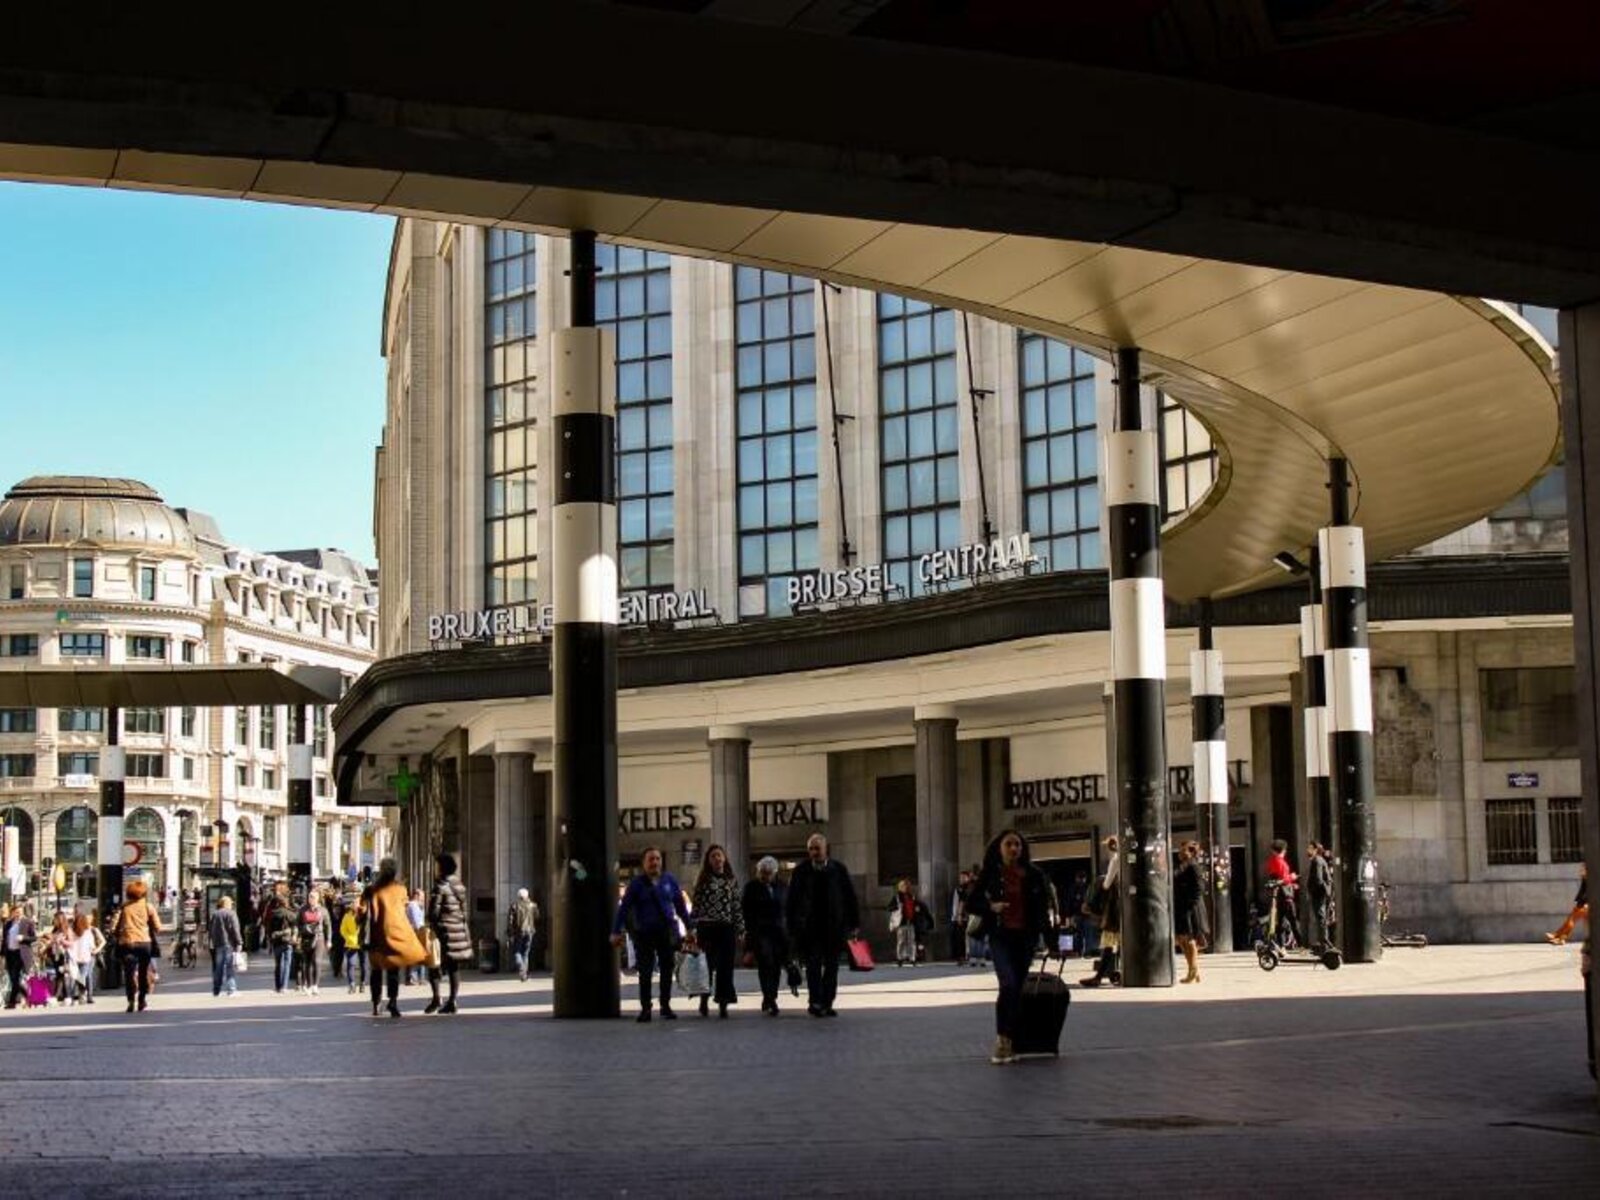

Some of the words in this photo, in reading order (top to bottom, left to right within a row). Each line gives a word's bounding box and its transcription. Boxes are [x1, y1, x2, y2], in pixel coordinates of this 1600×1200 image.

[787, 564, 895, 604] BRUSSEL
[918, 533, 1037, 583] CENTRAAL
[428, 605, 553, 640] BRUXELLE
[617, 589, 713, 624] ENTRAL
[1005, 773, 1107, 809] BRUSSEL
[618, 805, 696, 834] XELLES
[749, 798, 824, 826] NTRAL
